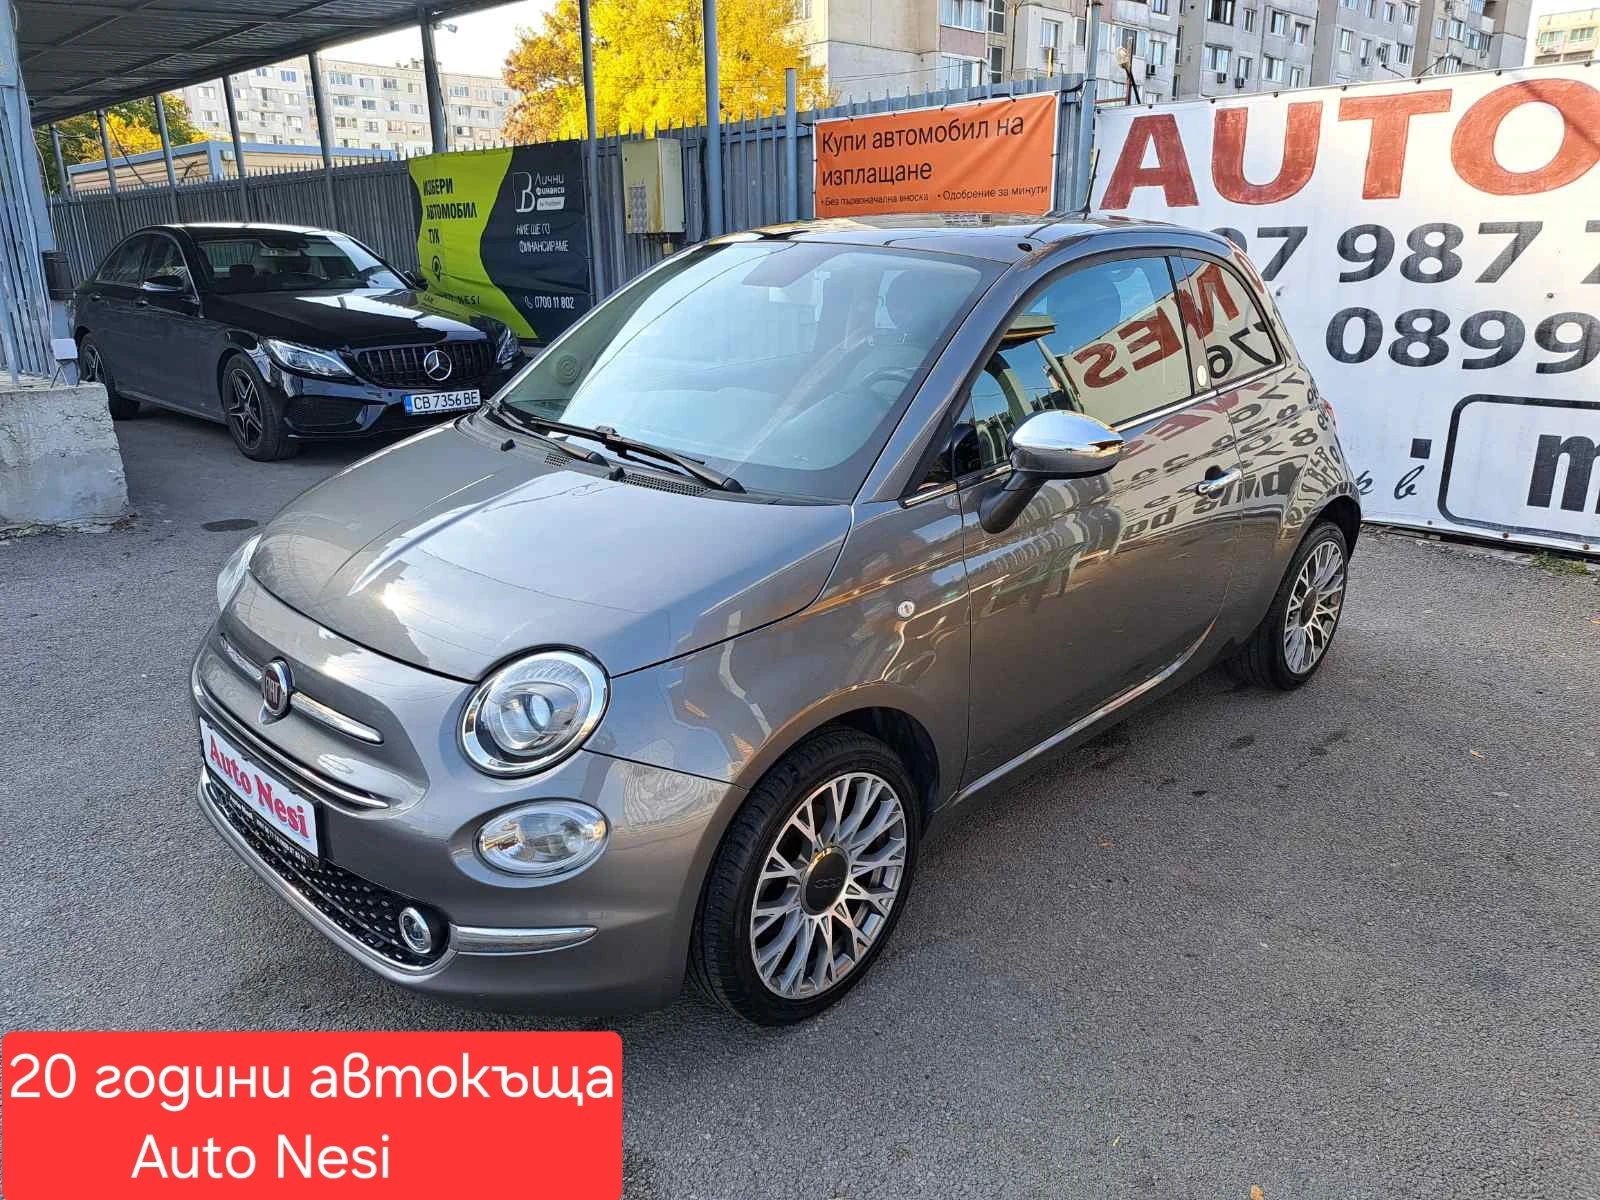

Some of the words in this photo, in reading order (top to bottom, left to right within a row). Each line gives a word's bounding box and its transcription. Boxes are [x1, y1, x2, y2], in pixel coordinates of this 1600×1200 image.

[822, 131, 866, 157] Купи
[872, 119, 989, 148] автомобил
[997, 116, 1024, 136] на
[1099, 78, 1600, 210] AUTO
[535, 172, 565, 185] Лични
[822, 162, 932, 187] изплащане
[423, 178, 454, 197] ИЗБЕРИ
[943, 190, 997, 201] Одобрение
[998, 188, 1009, 198] за
[1011, 185, 1048, 197] минути
[426, 202, 478, 221] АВТОМОБИЛ
[428, 228, 440, 244] ТУК
[1336, 221, 1543, 284] 987
[534, 296, 552, 309] 0700
[553, 296, 560, 309] 11
[1326, 306, 1600, 374] 0899
[414, 396, 431, 410] CB
[433, 394, 461, 408] 7356
[463, 391, 478, 405] BE
[210, 734, 252, 796] Auto
[254, 774, 310, 839] Nesi
